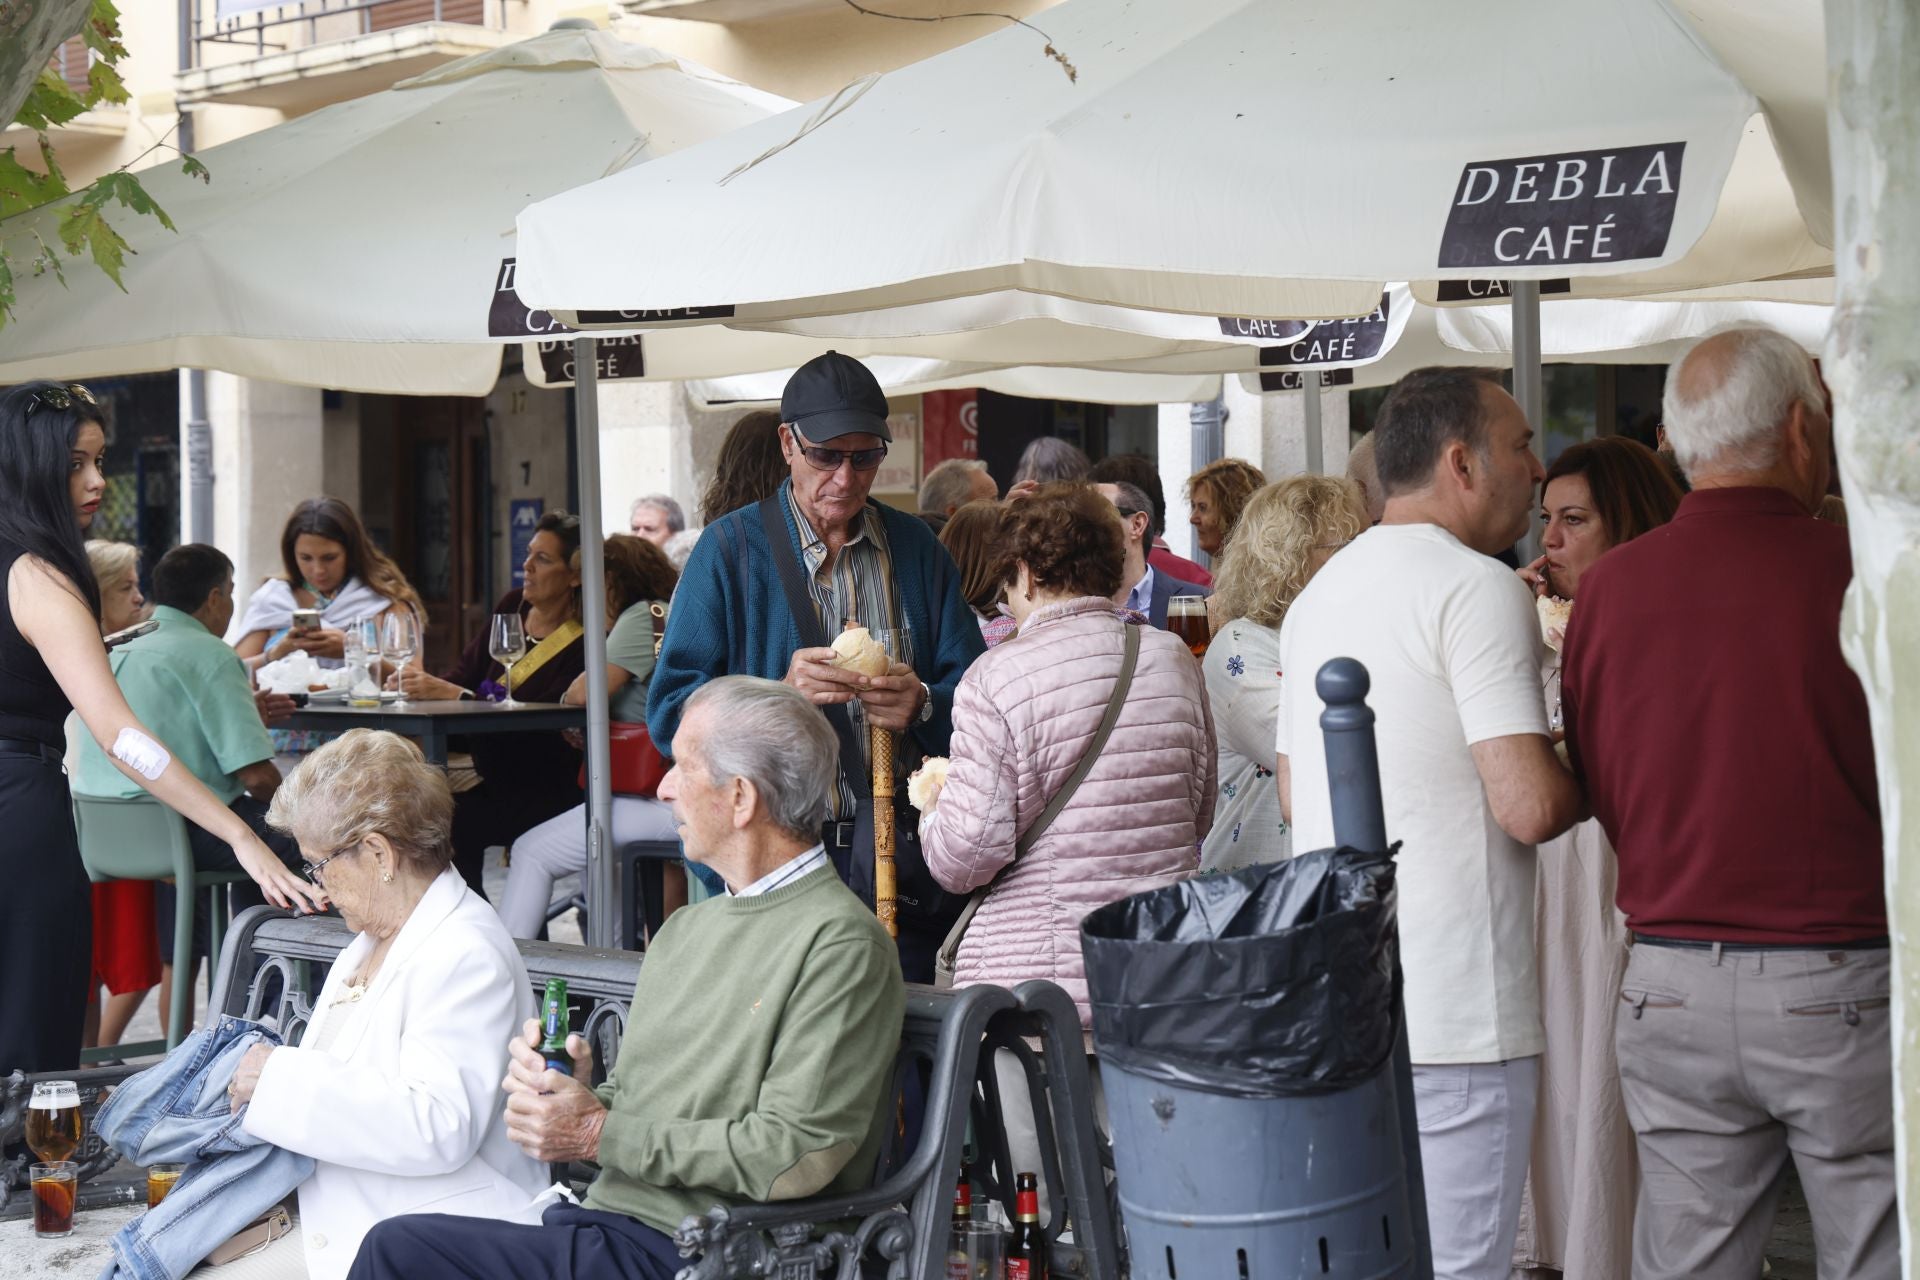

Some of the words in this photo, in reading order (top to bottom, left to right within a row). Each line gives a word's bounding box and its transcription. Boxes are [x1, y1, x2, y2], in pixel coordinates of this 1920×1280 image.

[1456, 150, 1675, 206] DEBLA
[1493, 213, 1616, 262] CAFÉ
[562, 353, 620, 379] CFÉ
[1290, 332, 1355, 362] CAFÉ
